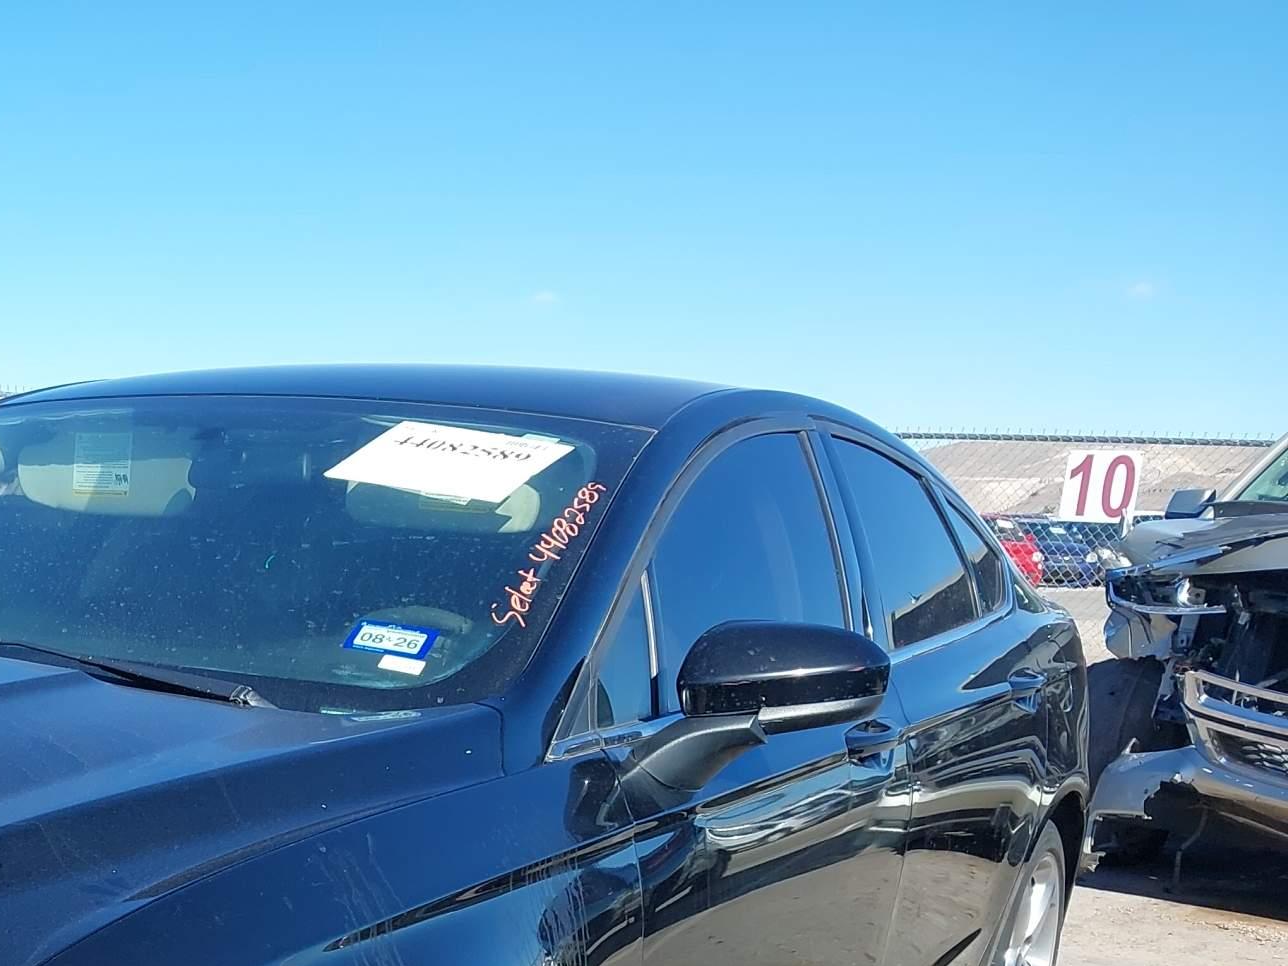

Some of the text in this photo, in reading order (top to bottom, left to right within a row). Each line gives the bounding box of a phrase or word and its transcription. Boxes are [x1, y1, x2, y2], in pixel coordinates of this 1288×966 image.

[1069, 453, 1137, 519] 10
[528, 482, 607, 562] 44082589
[360, 632, 385, 644] 08
[393, 637, 420, 649] 26
